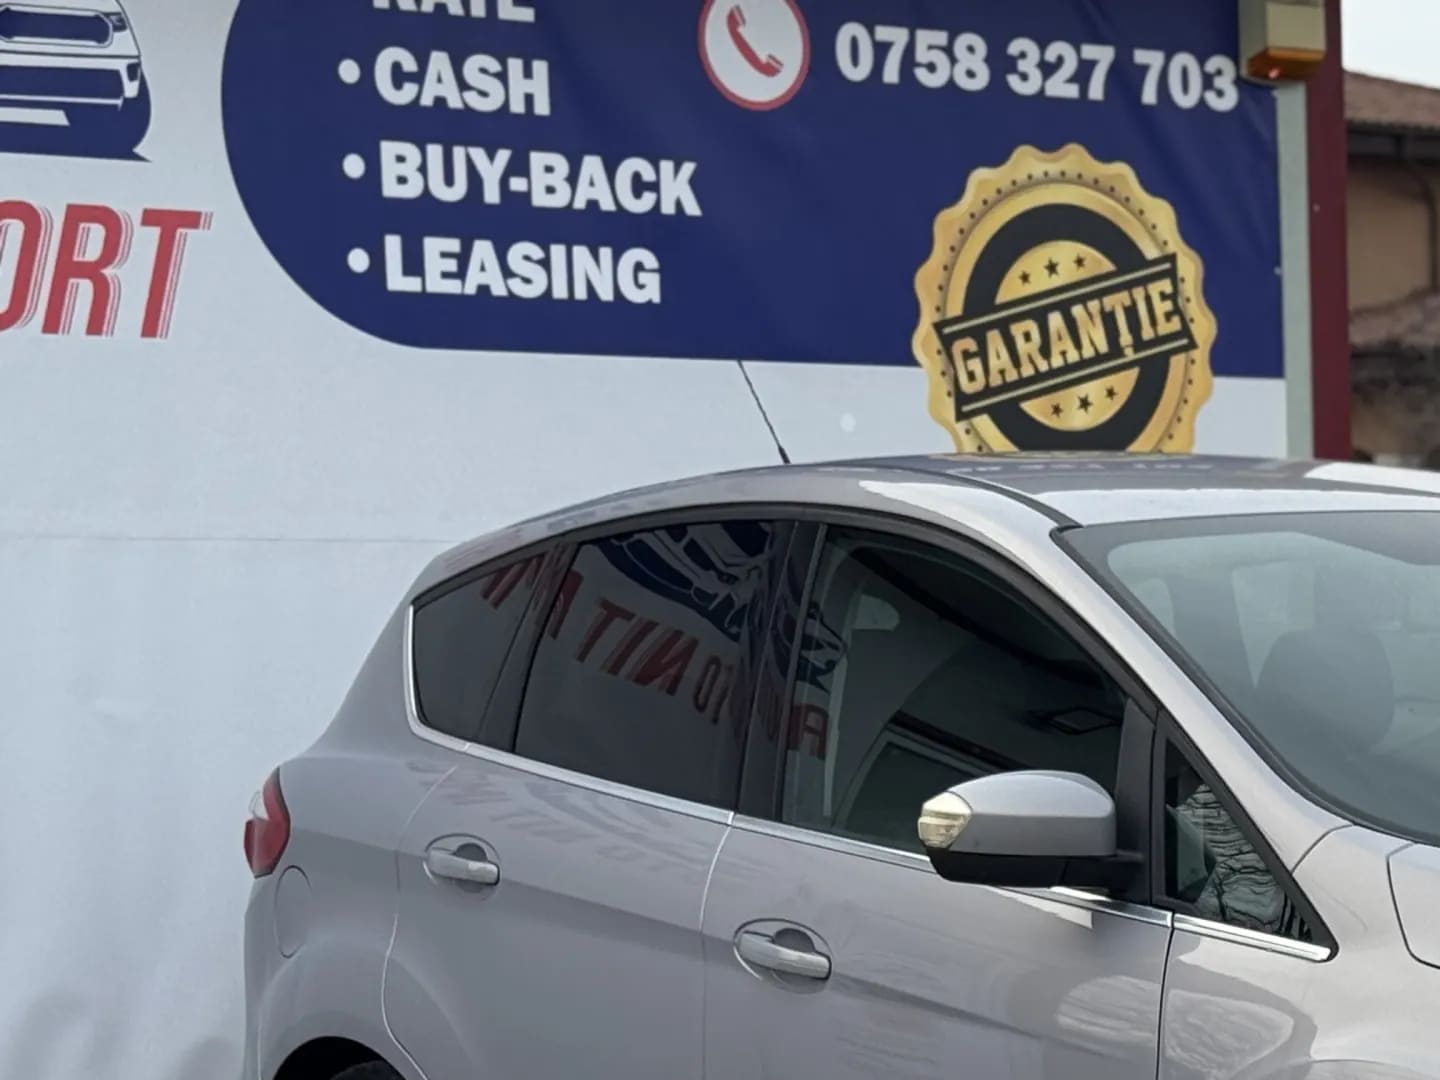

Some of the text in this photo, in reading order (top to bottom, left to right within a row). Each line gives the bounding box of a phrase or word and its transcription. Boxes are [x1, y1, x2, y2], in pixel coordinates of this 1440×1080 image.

[374, 46, 550, 116] CASH
[835, 22, 1238, 112] 0758 327 703
[379, 141, 702, 216] BUY-BACK
[384, 234, 661, 304] LEASING
